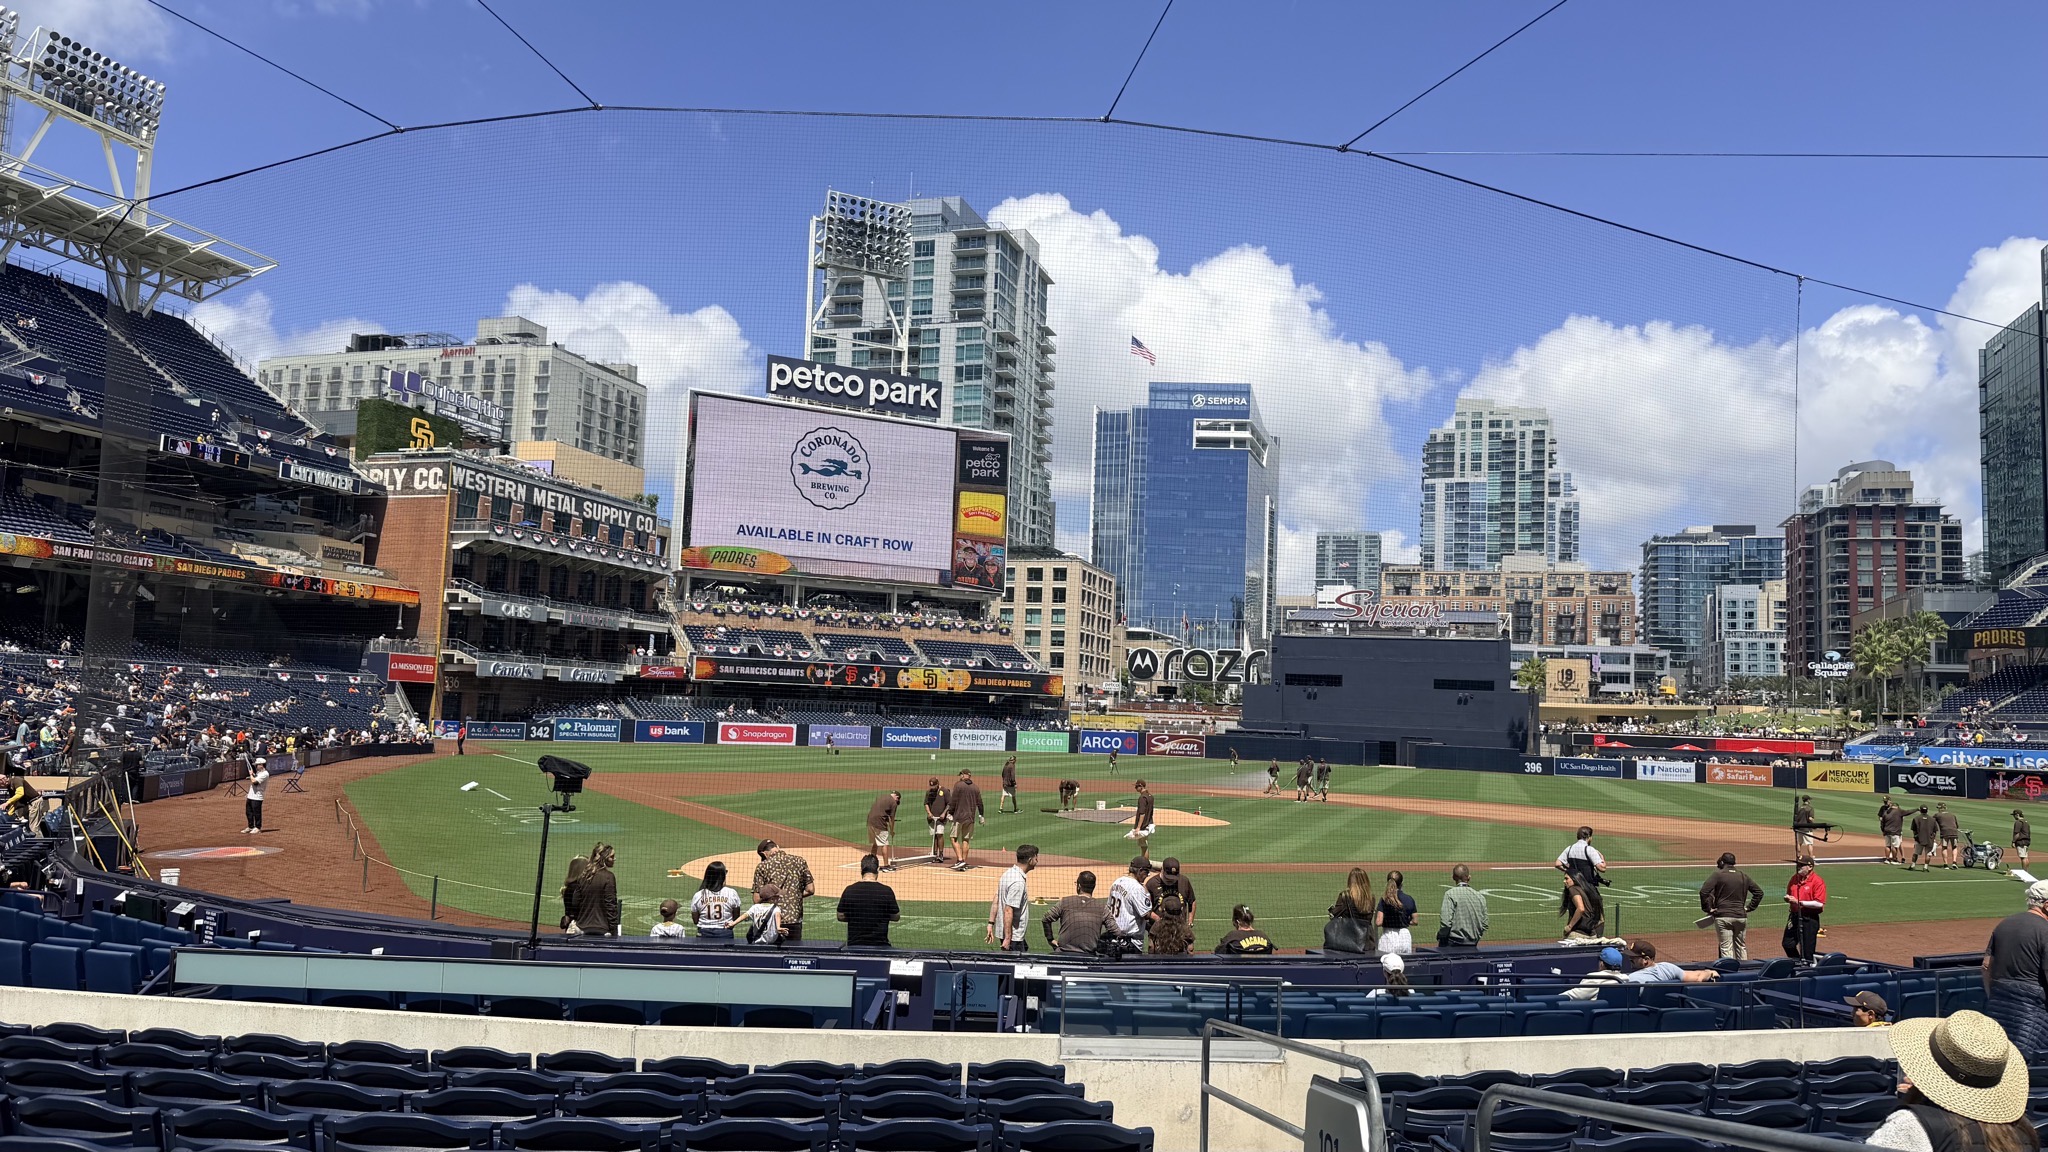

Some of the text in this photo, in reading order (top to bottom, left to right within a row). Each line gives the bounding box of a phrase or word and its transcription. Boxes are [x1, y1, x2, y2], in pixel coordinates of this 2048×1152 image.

[441, 347, 475, 357] Marriott
[770, 362, 939, 409] petco park
[422, 380, 505, 420] QuidelOrtho
[1207, 397, 1247, 405] SEMPRA
[800, 434, 861, 464] CORONADO
[966, 459, 1000, 469] petco
[292, 465, 353, 491] CUTWATER
[361, 466, 448, 491] PLY CO.
[971, 468, 999, 478] park
[810, 481, 849, 493] BREWING
[452, 466, 656, 534] WESTERN METAL SUPPLY CO.
[824, 491, 837, 501] CO.
[736, 523, 913, 552] AVAILABLE IN CRAFT ROW
[53, 545, 71, 557] SAN
[124, 554, 154, 567] GIANTS
[176, 562, 193, 573] SAN
[194, 564, 216, 576] DIEGO
[217, 567, 246, 580] PADRES
[710, 550, 757, 569] PADRES
[1333, 589, 1445, 627] Sycuan
[1973, 629, 2026, 648] PADRES
[398, 662, 422, 671] MISSION
[719, 664, 805, 678] SAN FRANCISCO GIANTS
[1163, 648, 1267, 682] razr
[1808, 662, 1855, 671] Gallagher
[1561, 669, 1573, 681] 19
[1814, 669, 1848, 678] Square
[974, 677, 1032, 688] SAN DIEGO PADRES
[530, 727, 550, 738] 342
[574, 721, 617, 733] Palomar
[742, 730, 787, 740] Snapdragon
[886, 733, 931, 743] Southwest
[1082, 737, 1122, 749] ARCO
[1150, 735, 1198, 754] Sycuan
[1524, 762, 1542, 773] 396
[1581, 764, 1597, 772] Diego
[1598, 764, 1616, 772] Health
[1828, 769, 1870, 779] MERCURY
[1898, 771, 1956, 787] EVOTEK
[1828, 777, 1870, 785] INSURANCE
[706, 904, 722, 920] 13
[1319, 1129, 1339, 1152] 101
